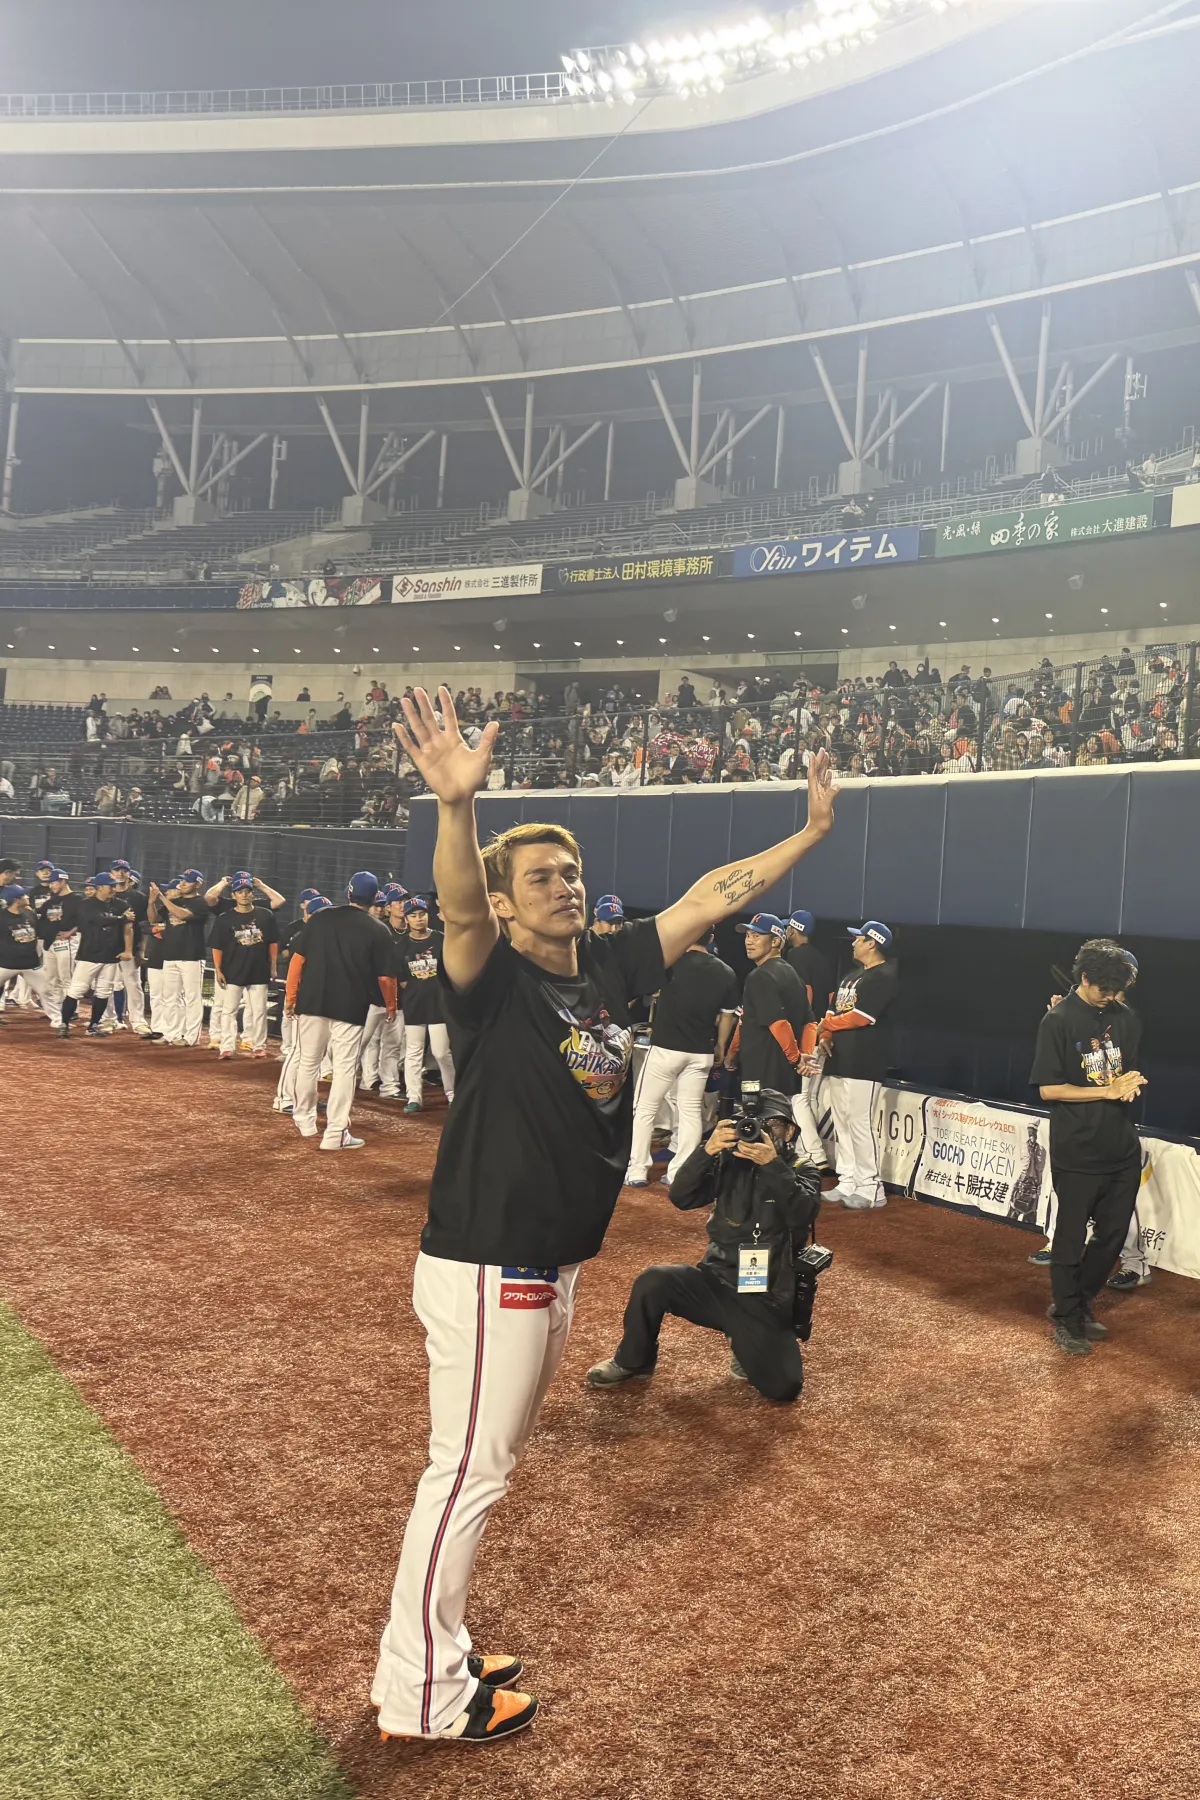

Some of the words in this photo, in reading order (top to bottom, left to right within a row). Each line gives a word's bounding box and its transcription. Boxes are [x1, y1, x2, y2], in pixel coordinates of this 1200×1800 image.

[990, 510, 1060, 546] 四季の家
[1070, 524, 1101, 537] 株式会社
[1101, 514, 1149, 534] 大進建設
[801, 533, 898, 568] ワイテム
[569, 567, 620, 583] 行政書士法人
[621, 555, 714, 581] 田村環境事務所
[413, 577, 462, 593] Sanshin
[464, 578, 490, 589] 株式会社
[491, 573, 539, 589] 三進製作所
[979, 1136, 997, 1152] THE
[999, 1141, 1017, 1155] SKY
[970, 1151, 1016, 1178] GIKEN
[925, 1169, 952, 1188] 株式会社
